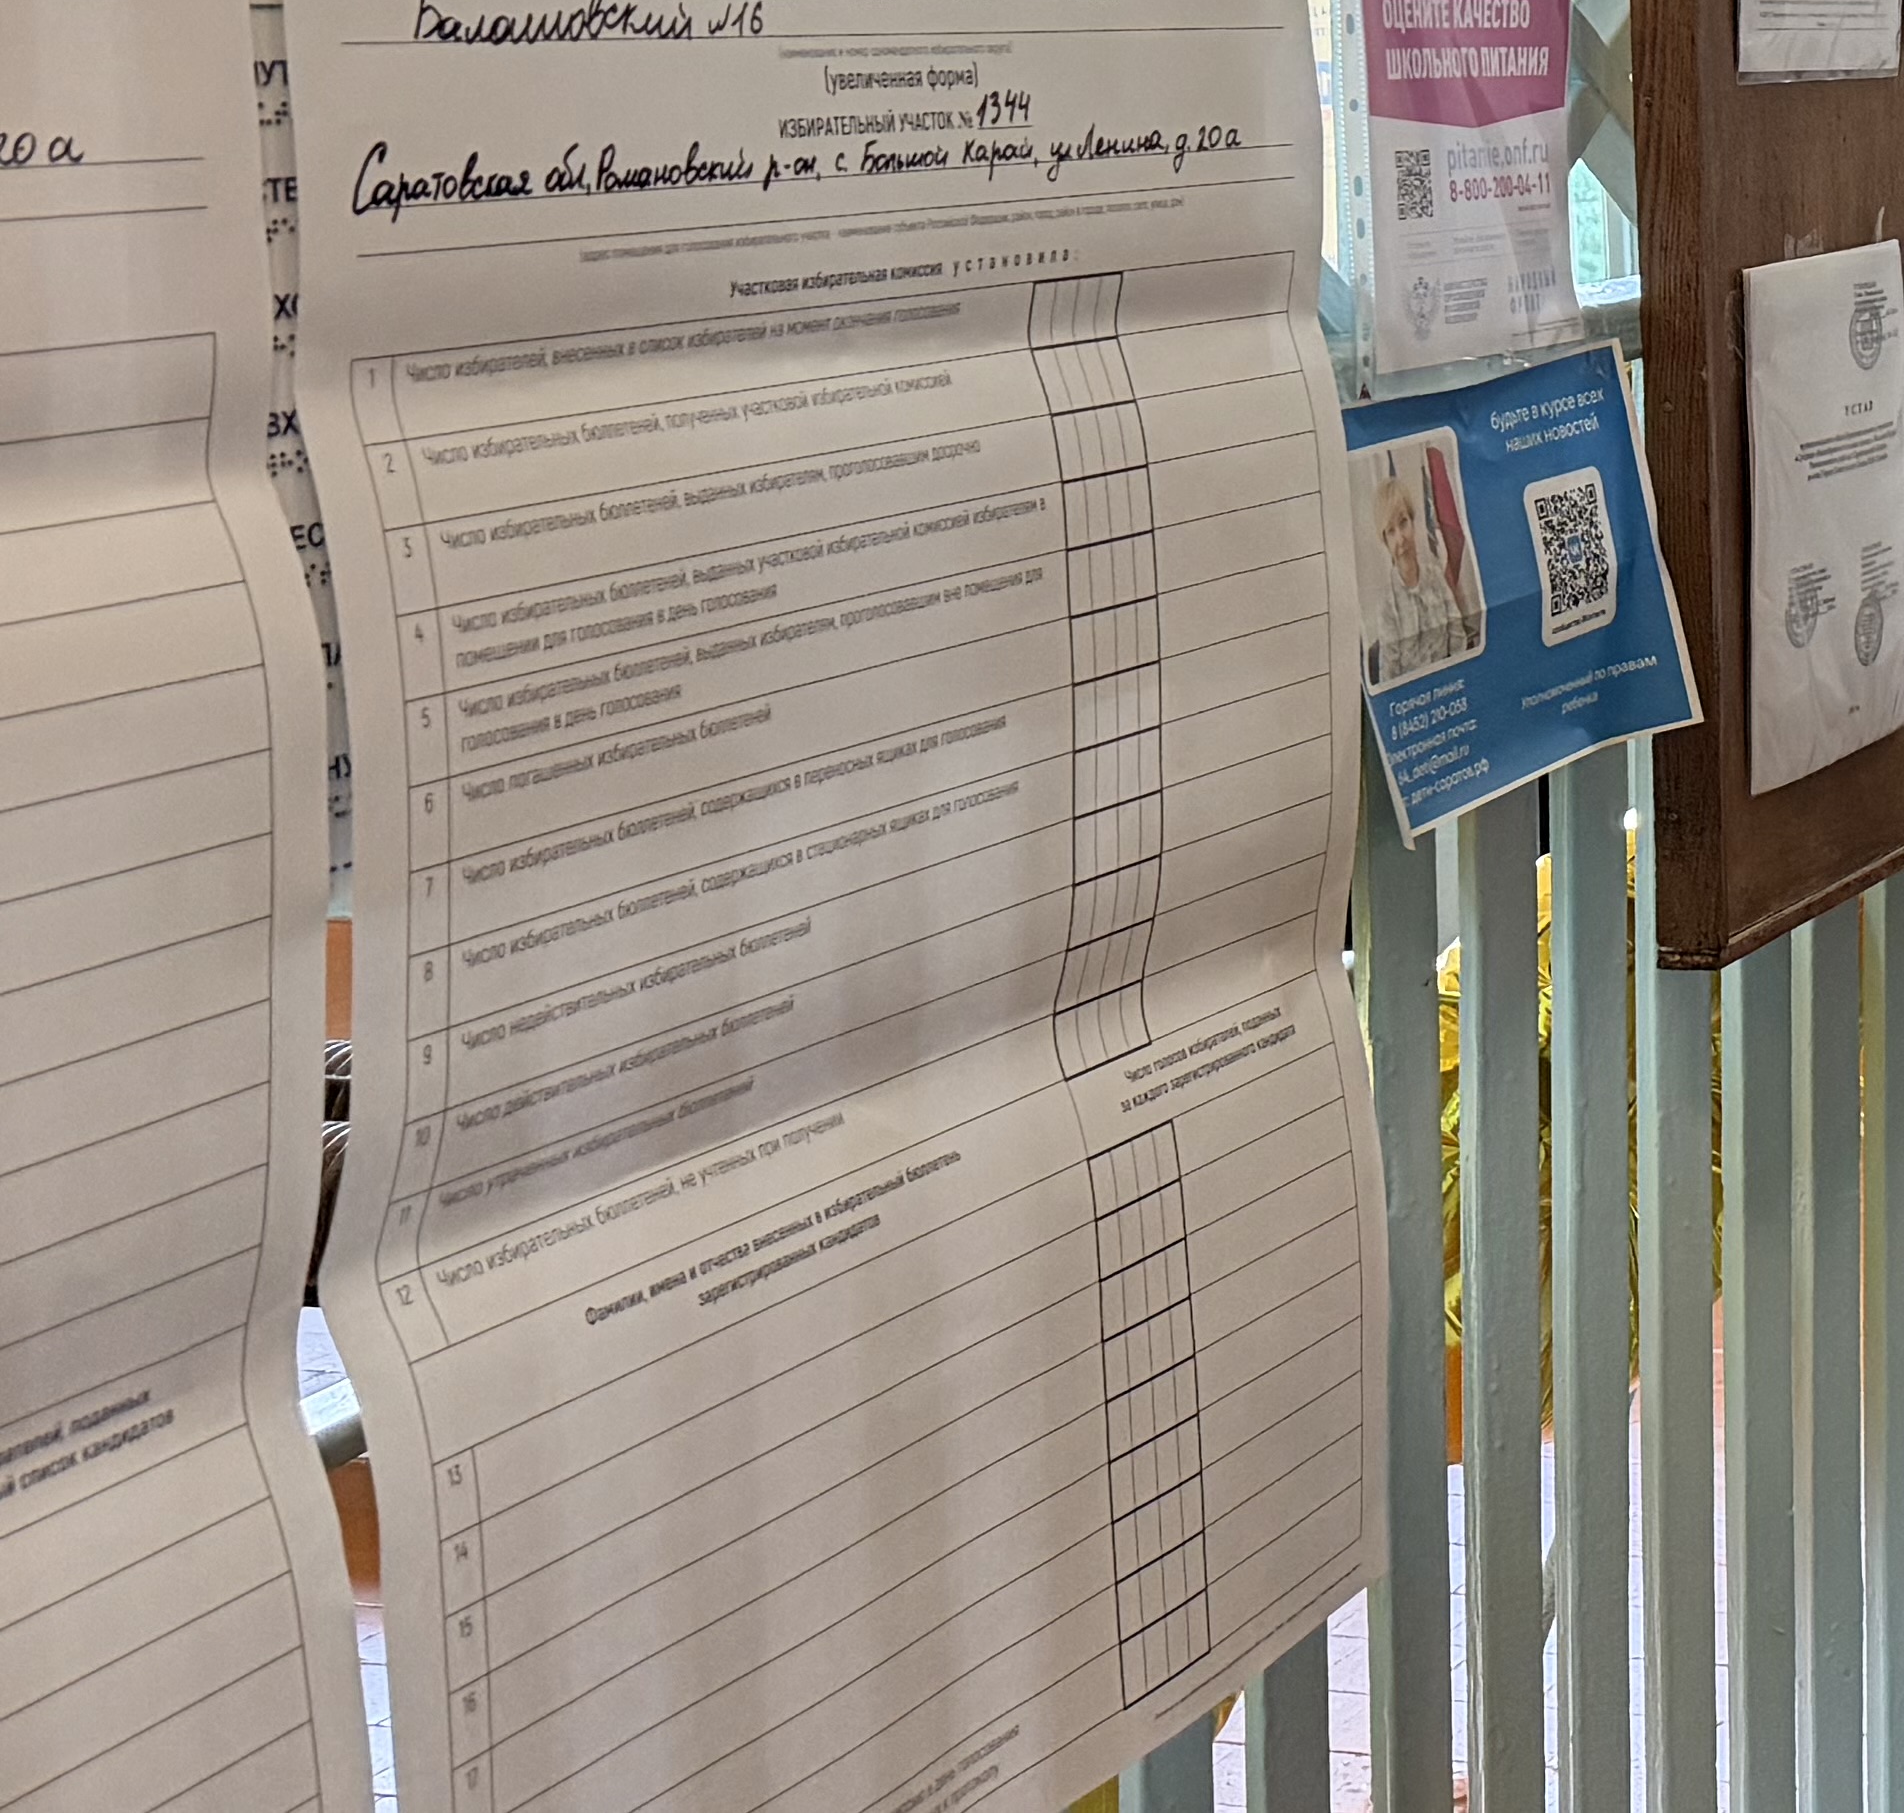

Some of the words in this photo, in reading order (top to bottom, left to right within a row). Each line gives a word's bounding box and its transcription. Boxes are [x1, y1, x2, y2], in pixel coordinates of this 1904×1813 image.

[824, 65, 922, 95] (увеличенная
[927, 62, 978, 90] форма)
[1386, 47, 1479, 80] ШКОЛЬНОГО
[1481, 46, 1550, 77] ПИТАНИЯ
[779, 109, 894, 138] ИЗБИРАТЕЛЬНЫЙ
[899, 111, 953, 132] УЧАСТОК
[977, 89, 1032, 127] 1344
[352, 140, 533, 224] Саратовская
[861, 139, 950, 175] Большой
[1450, 172, 1551, 203] 8-800-200-04-11
[730, 277, 797, 297] Участковая
[801, 268, 886, 289] избирательная
[891, 262, 941, 280] комиссия
[423, 445, 468, 466] Число
[472, 430, 579, 459] избирательных
[582, 413, 660, 443] бюллетеней,
[666, 406, 738, 428] полученных
[742, 390, 808, 421] участковой
[812, 377, 892, 405] избирательной
[895, 373, 952, 393] комиссией
[1490, 407, 1530, 432] будьте
[1540, 395, 1576, 419] курсе
[1577, 388, 1604, 407] всех
[1505, 430, 1543, 452] наших
[1544, 412, 1600, 443] новостей
[386, 454, 395, 474] 2
[404, 538, 413, 558] 3
[415, 625, 424, 643] 4
[1608, 655, 1658, 677] правам
[421, 708, 432, 729] 5
[424, 794, 434, 814] 6
[425, 878, 433, 897] 7
[423, 961, 434, 983] 8
[422, 1045, 432, 1066] 9
[437, 1259, 483, 1286] Число
[488, 1215, 592, 1270] избирательных
[598, 1181, 675, 1224] бюллетеней,
[681, 1173, 696, 1188] не
[759, 1139, 779, 1156] при
[783, 1112, 843, 1145] получении
[585, 1290, 645, 1325] Фамилии,
[650, 1270, 686, 1297] имена
[690, 1266, 696, 1279] и
[700, 1242, 749, 1275] отчества
[753, 1215, 812, 1252] внесенных
[817, 1211, 821, 1223] в
[824, 1175, 903, 1219] избирательный
[907, 1151, 960, 1182] бюллетень
[699, 1242, 816, 1306] зарегистрированных
[819, 1214, 879, 1250] кандидатов
[396, 1286, 414, 1306] 12
